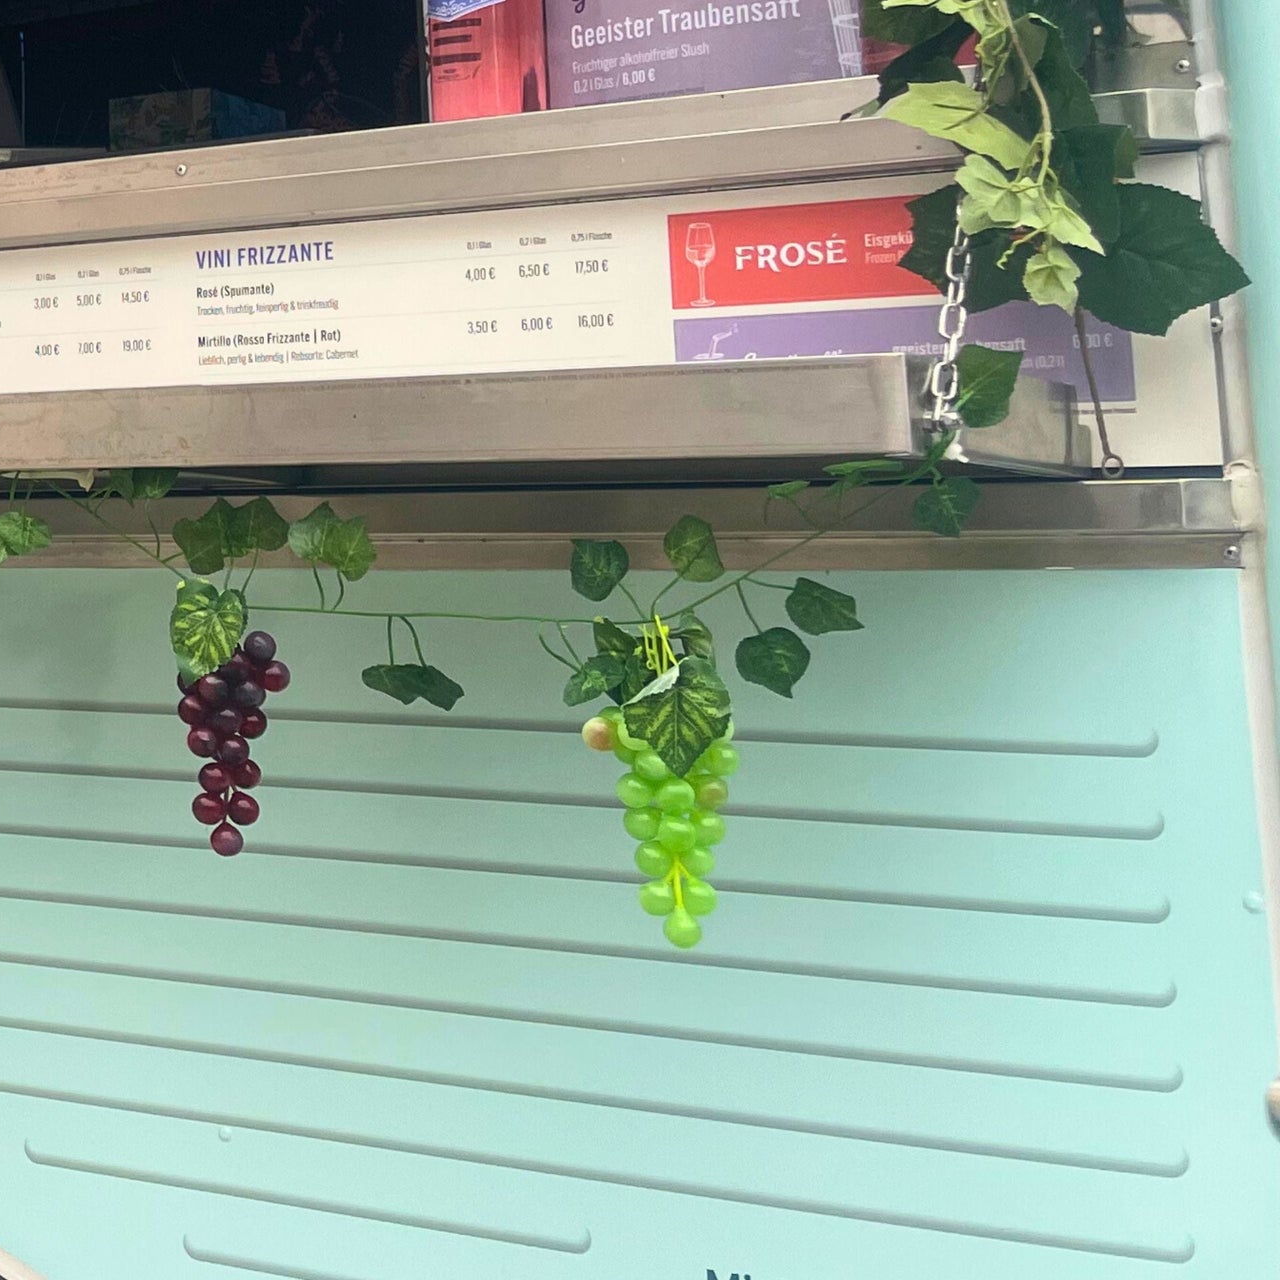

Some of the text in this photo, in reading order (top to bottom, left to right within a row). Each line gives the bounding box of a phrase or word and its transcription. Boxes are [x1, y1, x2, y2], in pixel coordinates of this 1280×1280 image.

[571, 16, 654, 49] Geeister
[572, 42, 710, 74] Fruchtiger alkoholfreier Slush
[594, 76, 614, 91] Glas
[622, 70, 646, 87] 6,00
[648, 67, 656, 81] €
[196, 241, 334, 269] VINI FRIZZANTE
[734, 230, 913, 273] FROSÉ Eisgekü
[196, 259, 609, 299] Rosé (Spumante) 4,00 € 6,50 € 17,50 €
[34, 297, 51, 309] 3,00
[53, 296, 59, 308] €
[76, 294, 94, 307] 5,00
[96, 293, 102, 305] €
[121, 290, 142, 304] 14,50
[143, 290, 150, 302] €
[198, 313, 614, 348] Mirtillo (Rosso Frizzante Rot) 3,50 € 6,00 € 16,00 €
[34, 344, 52, 356] 4,00
[54, 344, 60, 355] €
[96, 342, 102, 354] €
[122, 339, 144, 352] 19,00
[145, 339, 151, 350] €
